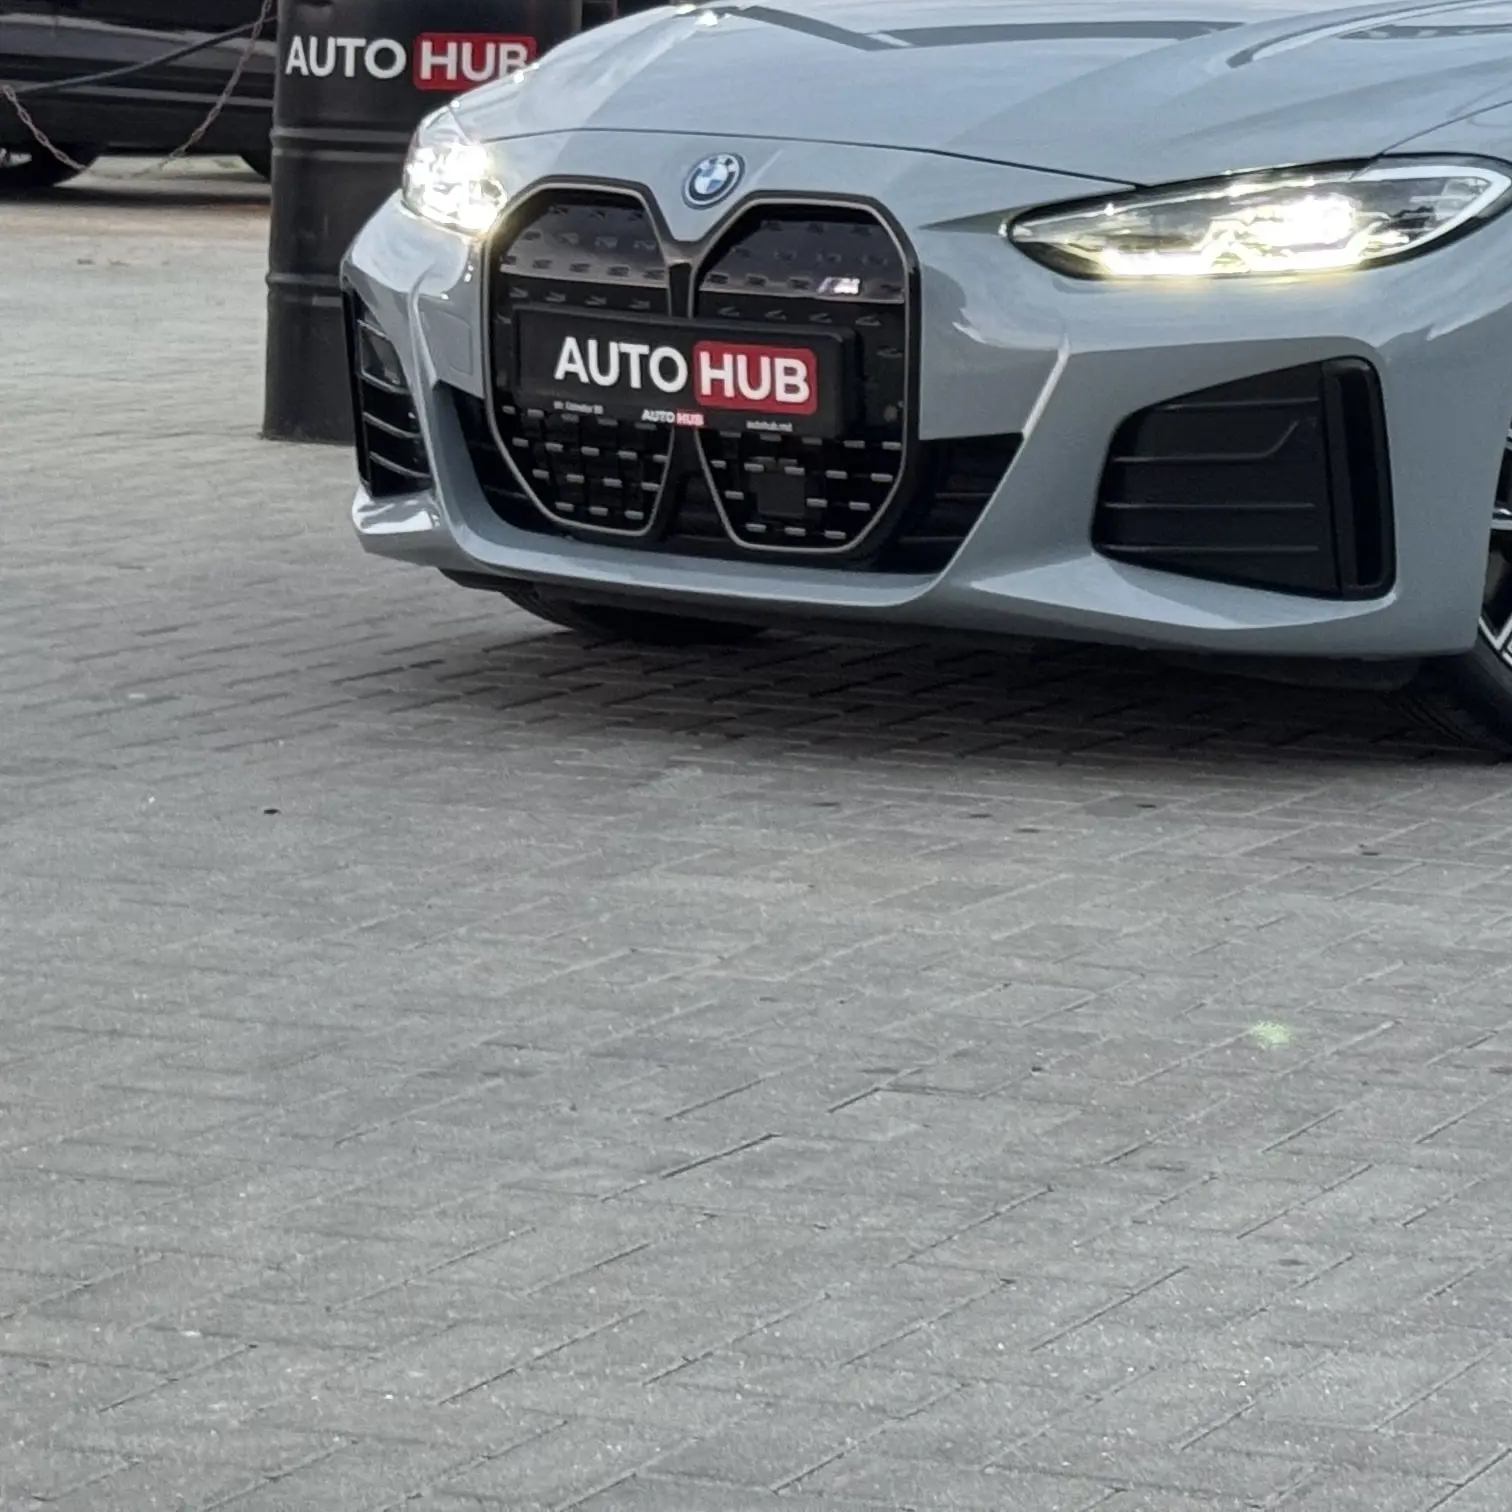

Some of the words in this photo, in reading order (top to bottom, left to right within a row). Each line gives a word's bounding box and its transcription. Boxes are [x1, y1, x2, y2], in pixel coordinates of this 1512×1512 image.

[285, 35, 407, 79] AUTO
[554, 336, 689, 393] AUTO
[699, 351, 811, 404] HUB
[641, 408, 676, 424] AUTO
